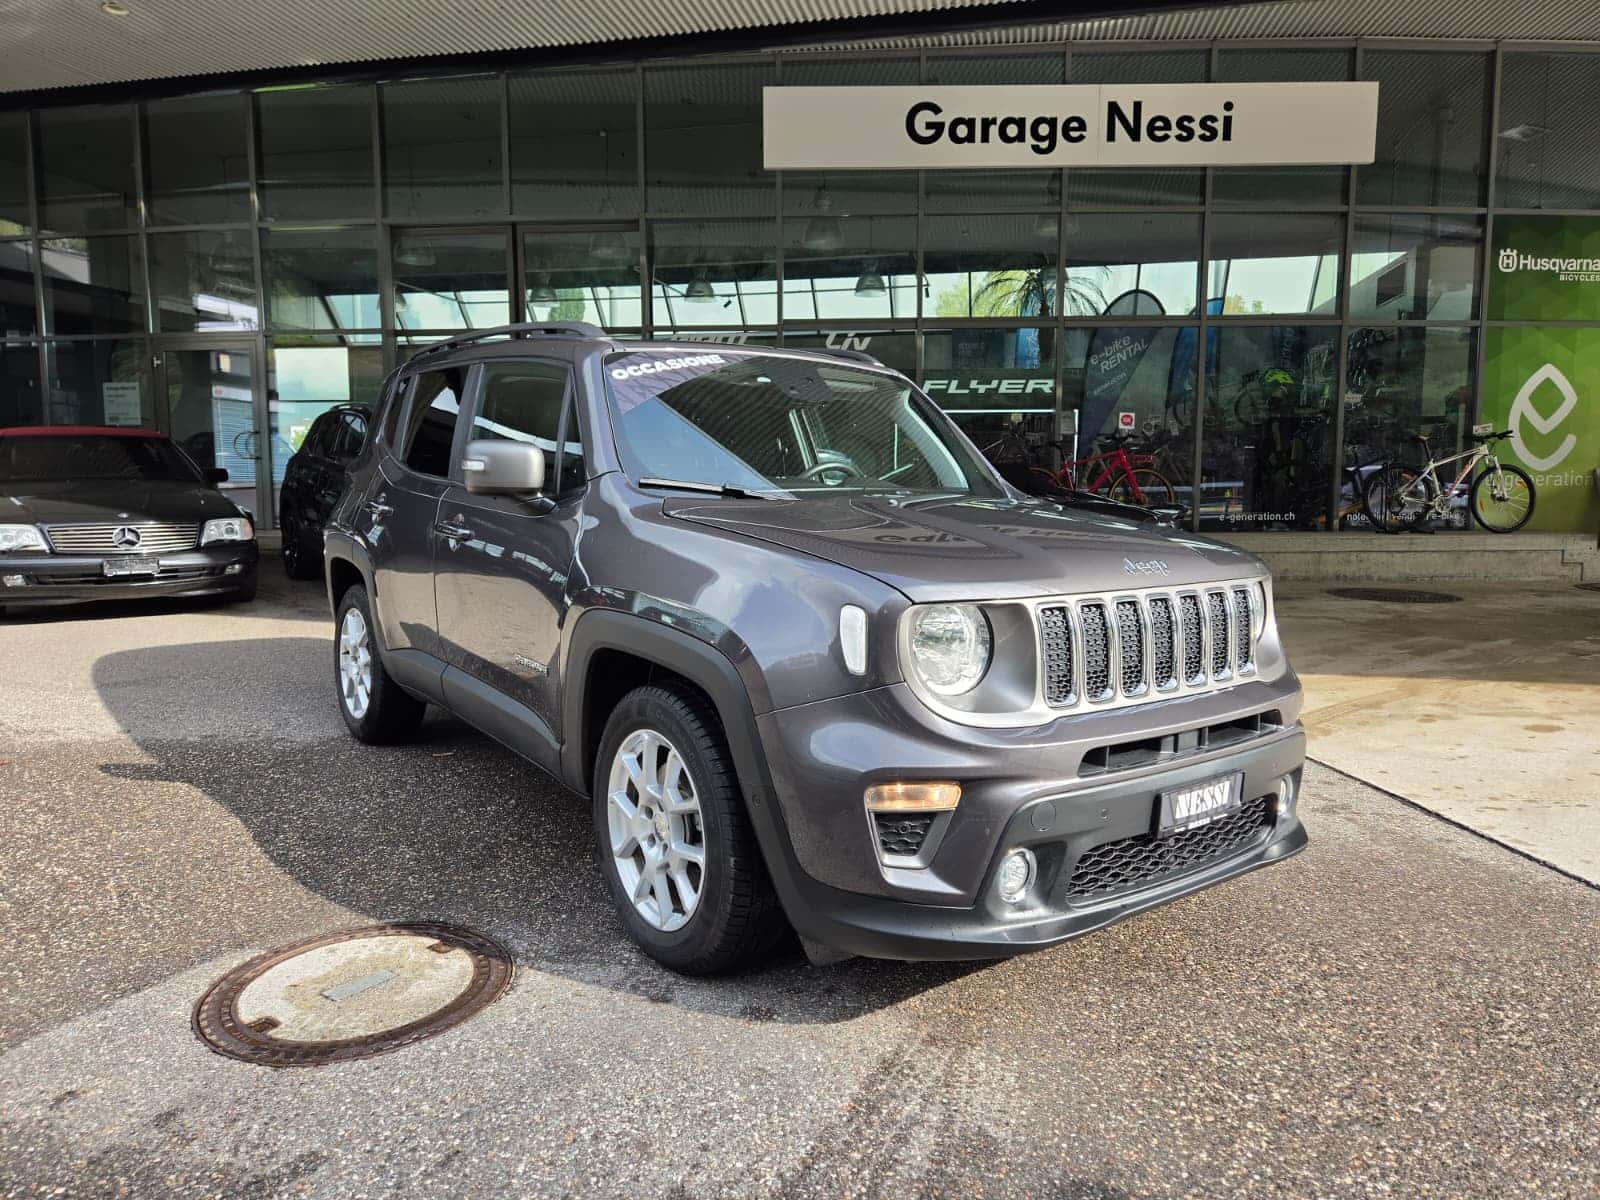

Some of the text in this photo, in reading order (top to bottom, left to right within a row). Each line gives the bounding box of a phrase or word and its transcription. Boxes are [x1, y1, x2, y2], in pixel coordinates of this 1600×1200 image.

[905, 101, 1235, 155] Garage Nessi
[1519, 254, 1600, 273] Husqvarna
[1090, 336, 1131, 365] e-bike
[1100, 339, 1149, 374] RENTAL
[611, 353, 726, 381] OCCASIONE
[922, 378, 1056, 394] FLYER
[1219, 511, 1296, 524] e-generation.ch
